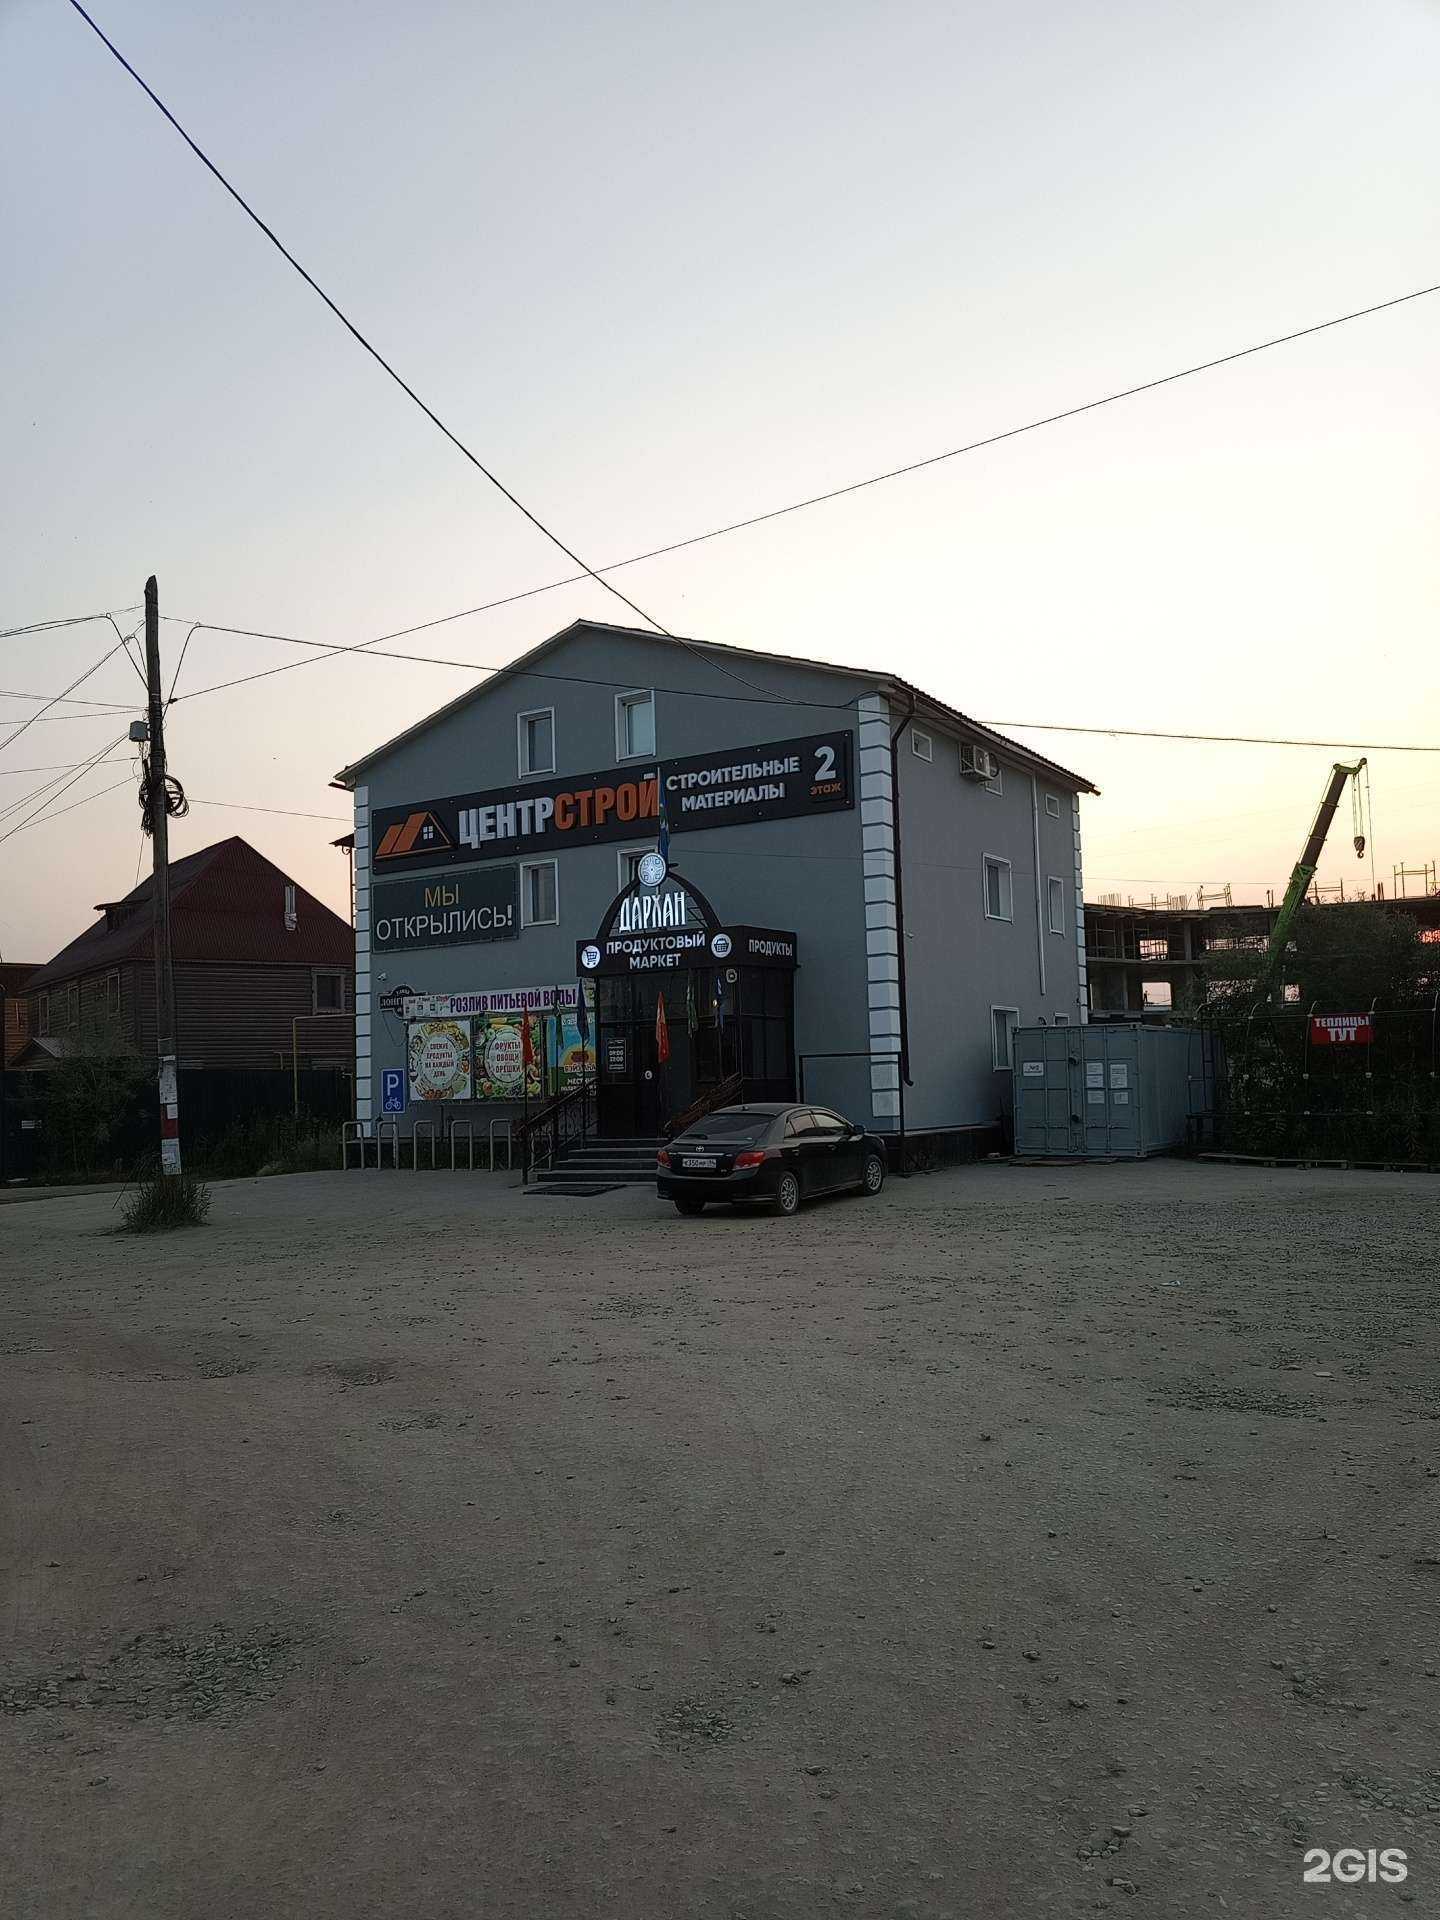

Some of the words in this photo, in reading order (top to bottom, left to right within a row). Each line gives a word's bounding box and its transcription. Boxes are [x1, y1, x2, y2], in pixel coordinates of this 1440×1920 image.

[666, 756, 800, 791] СТРОИТЕЛЬНЫЕ
[814, 746, 837, 781] 2
[681, 783, 785, 812] МАТЕРИАЛЫ
[809, 782, 842, 796] этаж
[458, 773, 660, 849] ЦЕНТРСТРОЙ
[424, 884, 460, 908] МЫ
[376, 904, 513, 940] ОТКРЫЛИСЬ!
[618, 891, 686, 933] ДАРХАН
[606, 931, 706, 955] ПРОДУКТОВЫЙ
[749, 939, 793, 957] ПРОДУКТЫ
[629, 953, 681, 969] МАРКЕТ
[450, 995, 488, 1013] РОЗЛИВ
[490, 988, 541, 1010] ПИТЬЕВОЙ
[1314, 1016, 1369, 1027] ТЕПЛИЦЫ
[495, 1040, 521, 1050] ФРУКТЫ
[1328, 1027, 1357, 1041] ТУТ
[496, 1052, 519, 1062] ОВОЩИ
[387, 1074, 399, 1096] P
